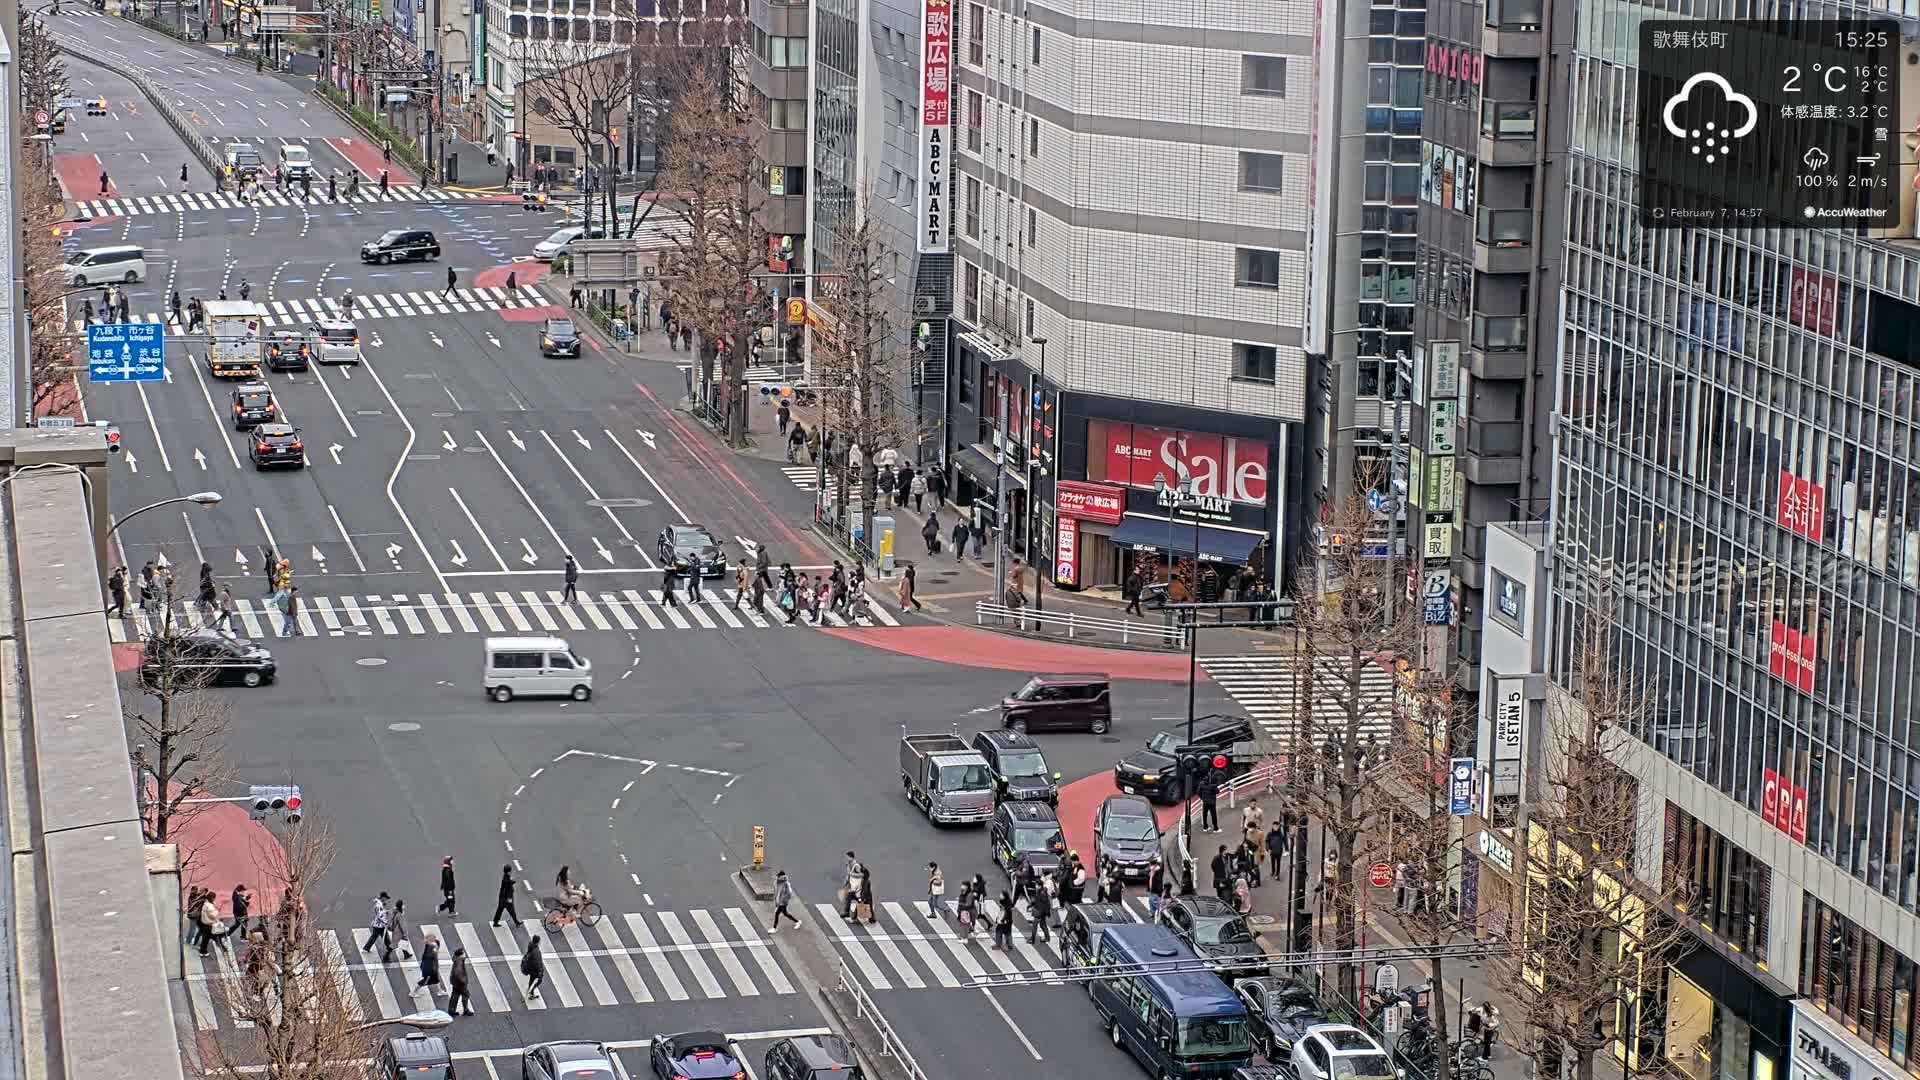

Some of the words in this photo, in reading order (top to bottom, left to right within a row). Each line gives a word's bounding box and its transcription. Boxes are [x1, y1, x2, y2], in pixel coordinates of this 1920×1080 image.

[926, 11, 948, 93] 歌広場
[1427, 43, 1481, 85] AMIGO
[925, 99, 948, 111] 受付
[925, 112, 947, 121] 5F
[928, 128, 942, 245] ABC-MART
[95, 326, 123, 335] 九段下
[138, 348, 160, 357] 渋谷
[1160, 437, 1267, 506] Sale
[1060, 491, 1086, 504] カラオケ
[1094, 496, 1118, 509] 歌広場
[1784, 482, 1820, 532] 会計
[1434, 514, 1444, 523] 7F
[1429, 527, 1442, 554] 買取
[1772, 641, 1815, 672] professona
[1498, 721, 1506, 739] PARK
[1507, 705, 1520, 746] ISETAN
[1765, 780, 1804, 829] CPA
